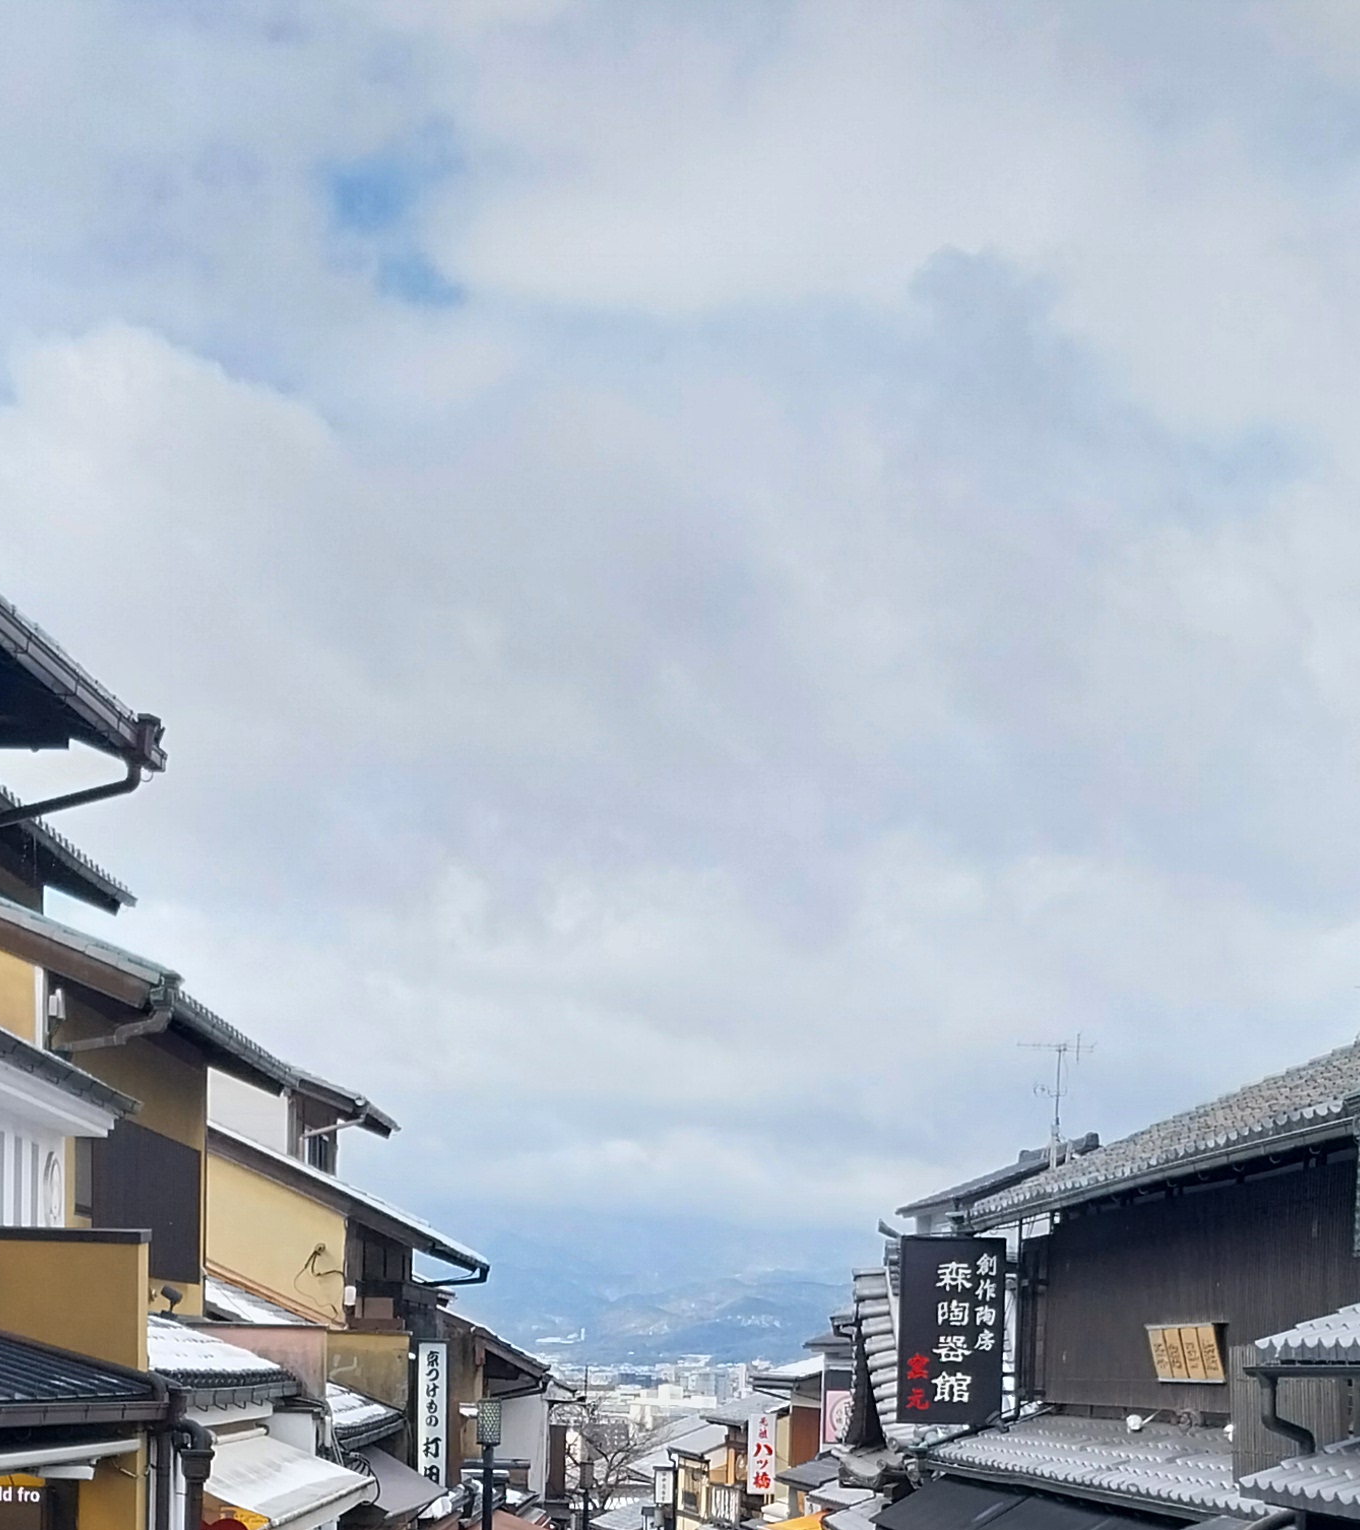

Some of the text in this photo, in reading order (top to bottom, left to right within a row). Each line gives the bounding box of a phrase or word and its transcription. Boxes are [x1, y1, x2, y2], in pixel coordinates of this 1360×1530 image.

[931, 1261, 973, 1403] 森陶器館
[974, 1253, 997, 1351] 創作陶房
[425, 1350, 440, 1427] 京つけもの
[17, 1486, 40, 1503] fro
